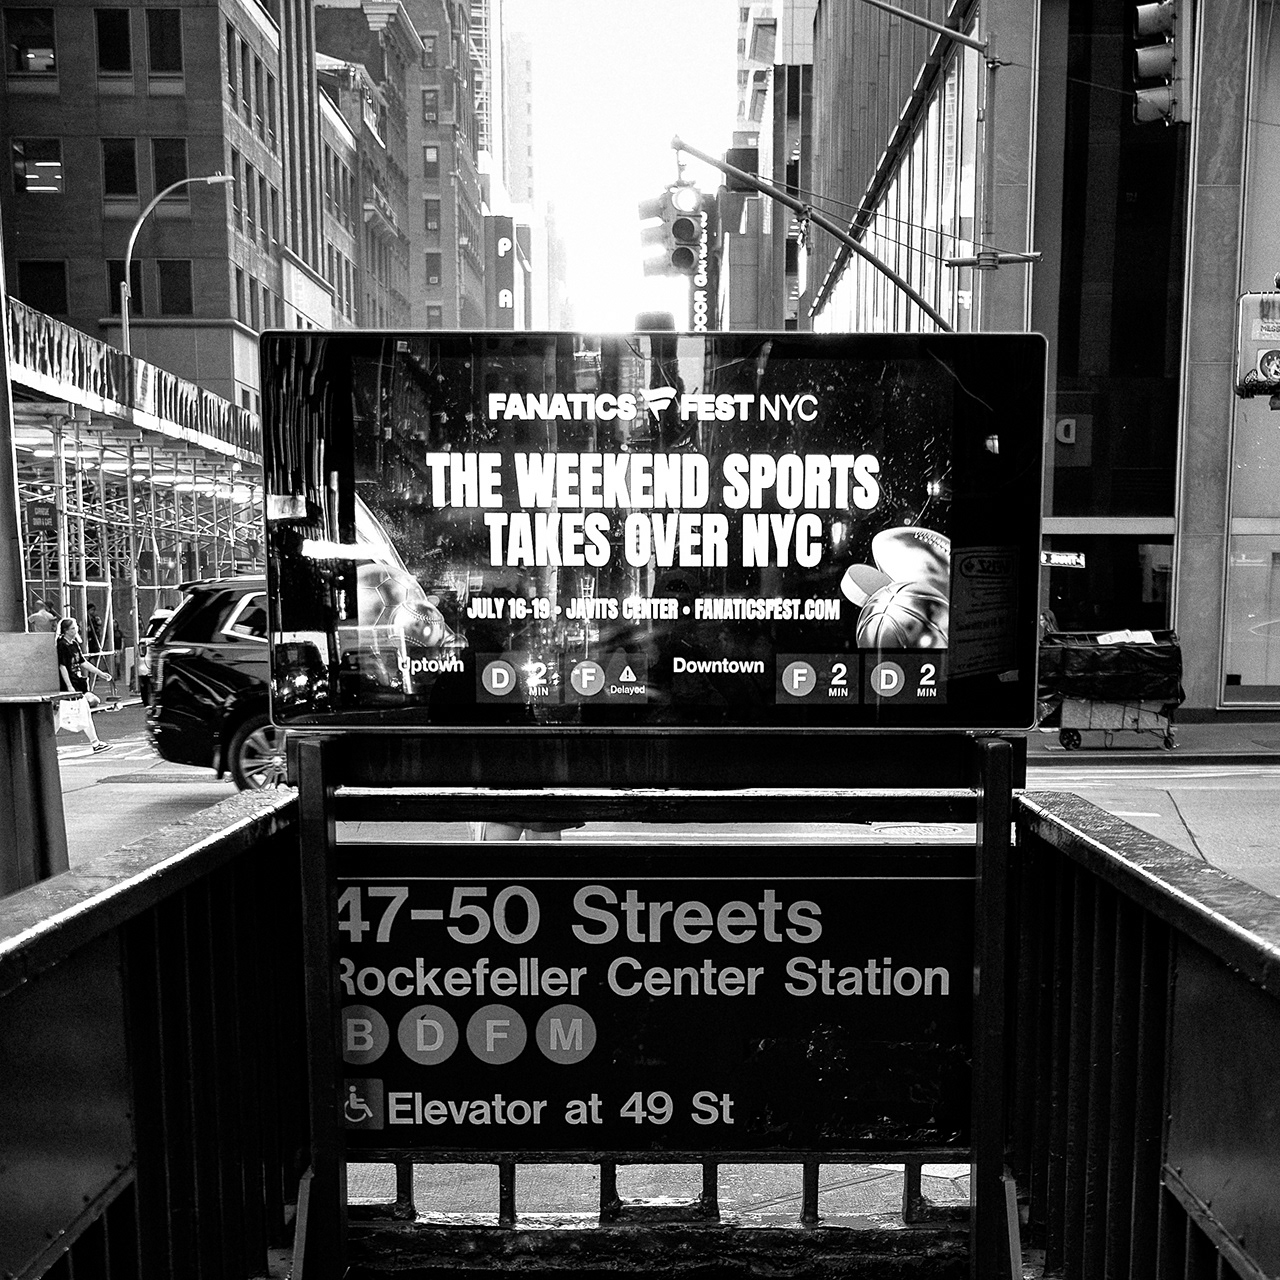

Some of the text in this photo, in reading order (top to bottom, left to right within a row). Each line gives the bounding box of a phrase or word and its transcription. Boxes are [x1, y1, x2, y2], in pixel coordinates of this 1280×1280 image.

[487, 392, 819, 422] FANATICS FEST NYC
[426, 452, 880, 510] THE WEEKEND SPORTS
[484, 513, 823, 567] TAKES OVER NYC
[466, 598, 841, 621] JULY 16-19 JAVITS CENTER FANATICSFEST.COM
[398, 656, 509, 688] Uptown D
[533, 662, 548, 684] 2
[581, 668, 596, 688] F
[673, 657, 936, 690] Downtown F 2 D 2
[529, 687, 549, 697] MIN
[610, 685, 646, 695] Delayed
[828, 688, 849, 697] MIN
[917, 688, 937, 697] MIN
[337, 885, 823, 945] 47-50 Streets
[339, 956, 950, 997] Rockefeller Center Station
[346, 1018, 583, 1052] B D F M
[388, 1090, 735, 1126] Elevator at 49 St
